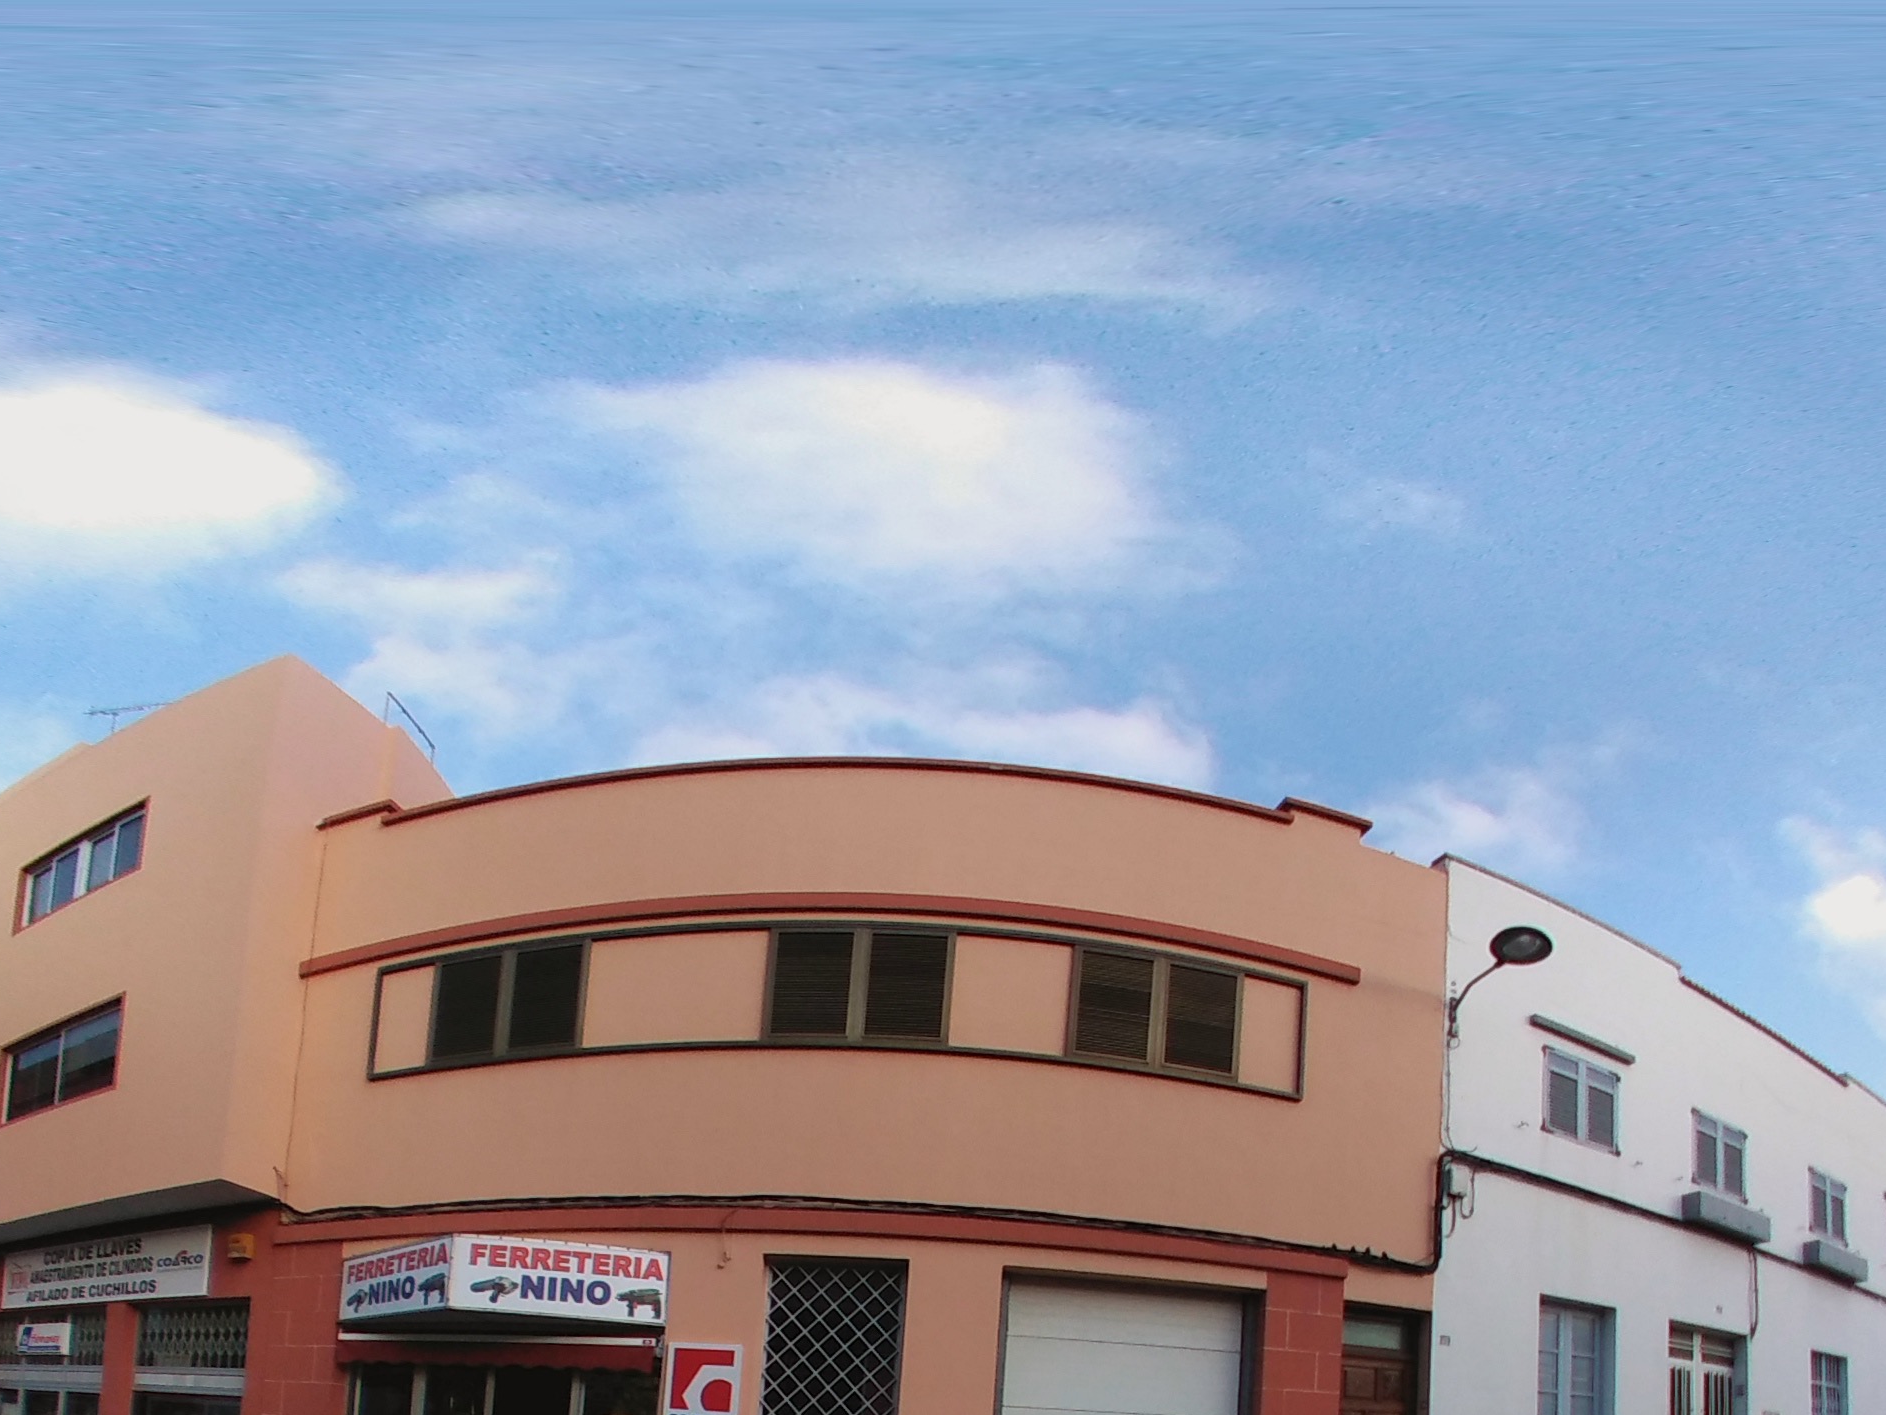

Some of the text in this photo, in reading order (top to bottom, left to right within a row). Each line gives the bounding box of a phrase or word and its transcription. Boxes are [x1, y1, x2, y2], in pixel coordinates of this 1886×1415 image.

[43, 1238, 142, 1266] COPIA DE LLAVES
[346, 1242, 449, 1285] FERRETERIA
[469, 1242, 664, 1282] FERRETERIA
[96, 1261, 108, 1278] DE
[26, 1279, 157, 1302] AFILADO DE CUCHILLOS
[367, 1275, 415, 1306] NINO
[518, 1274, 612, 1306] NINO
